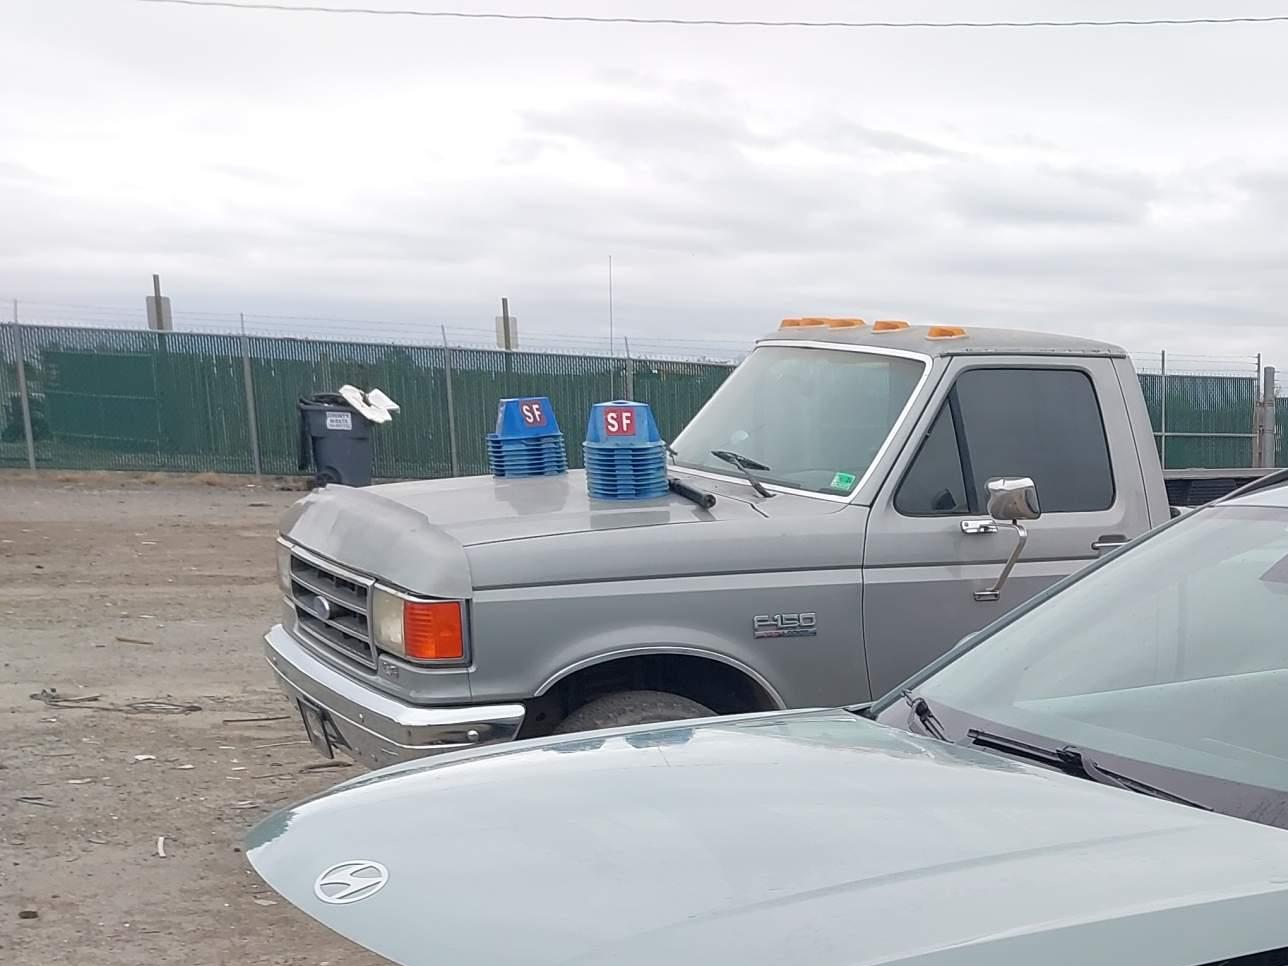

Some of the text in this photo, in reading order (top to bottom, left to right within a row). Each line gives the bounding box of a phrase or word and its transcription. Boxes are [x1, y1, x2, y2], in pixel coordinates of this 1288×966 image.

[522, 404, 542, 423] SF
[606, 412, 632, 432] SF
[753, 612, 817, 630] F-150
